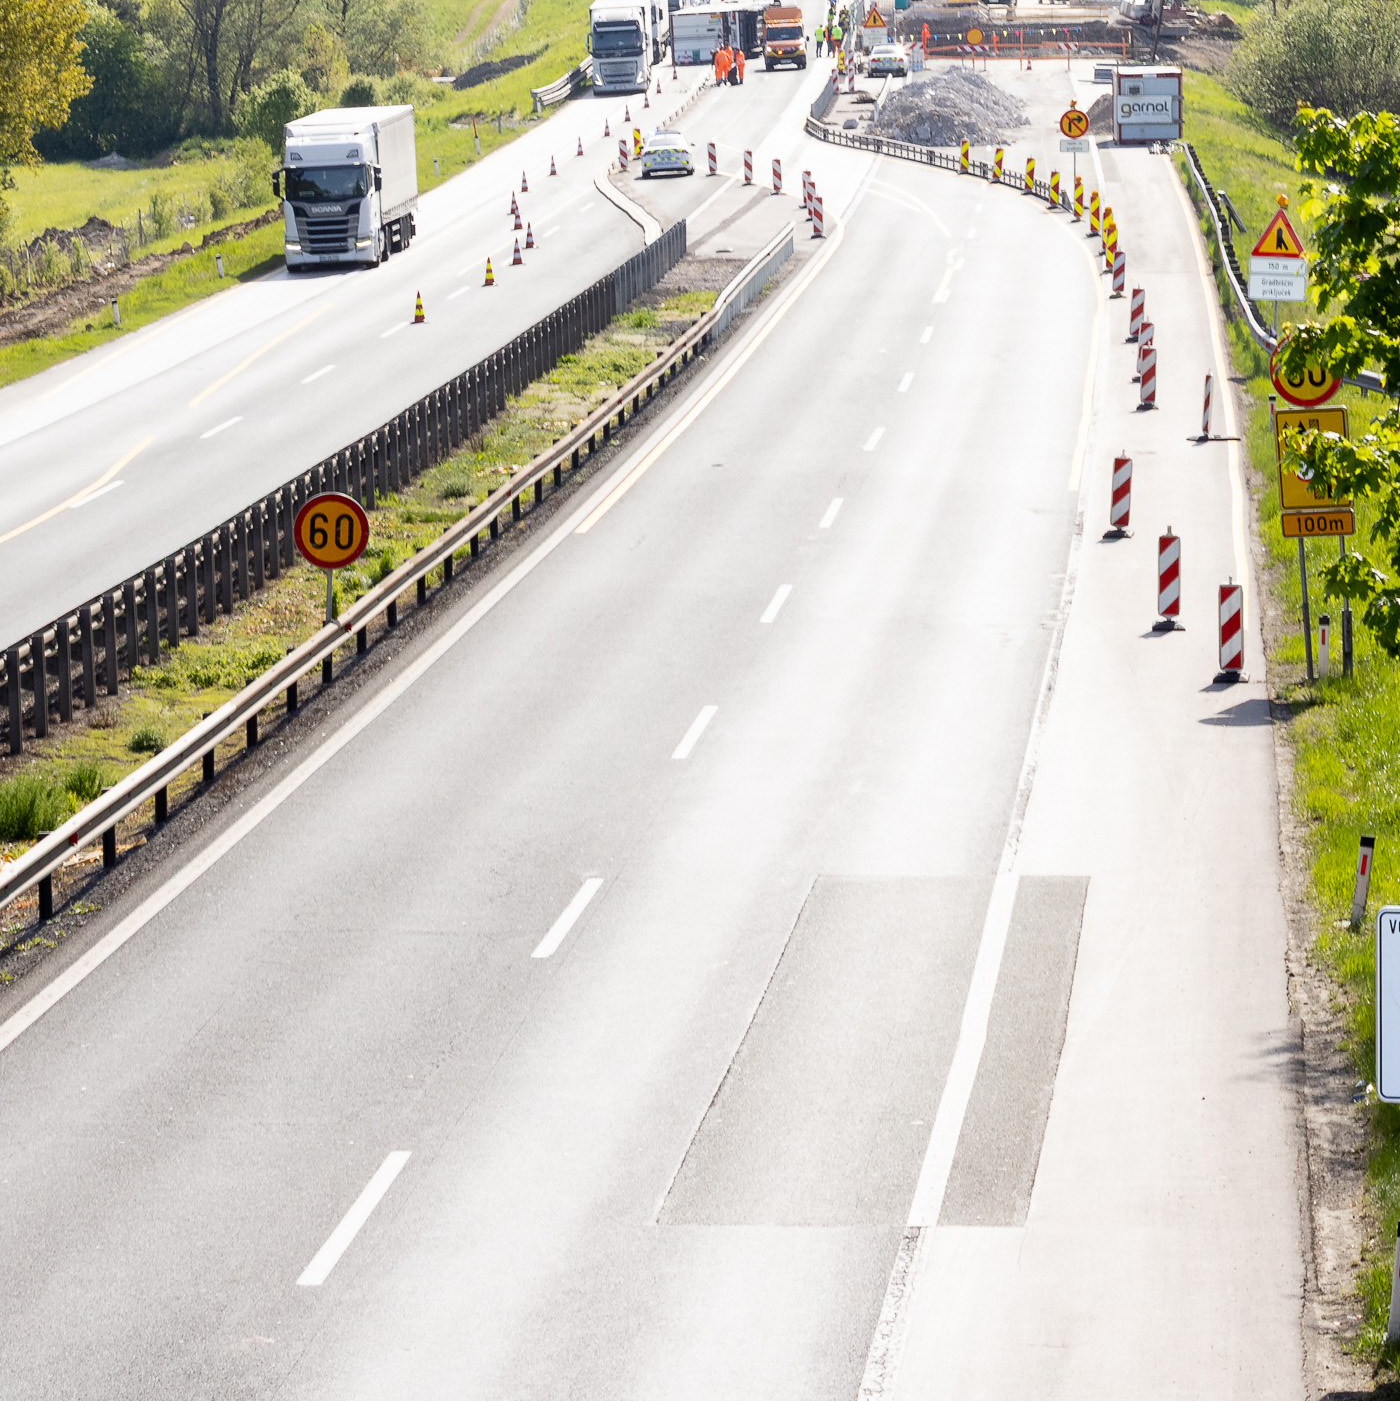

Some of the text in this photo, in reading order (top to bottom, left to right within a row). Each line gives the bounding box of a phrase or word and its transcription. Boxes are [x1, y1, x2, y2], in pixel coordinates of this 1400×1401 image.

[1121, 101, 1169, 117] garnol
[311, 205, 342, 213] SCANIA
[1268, 262, 1280, 270] 150
[309, 513, 354, 550] 60
[1297, 516, 1344, 533] 100m
